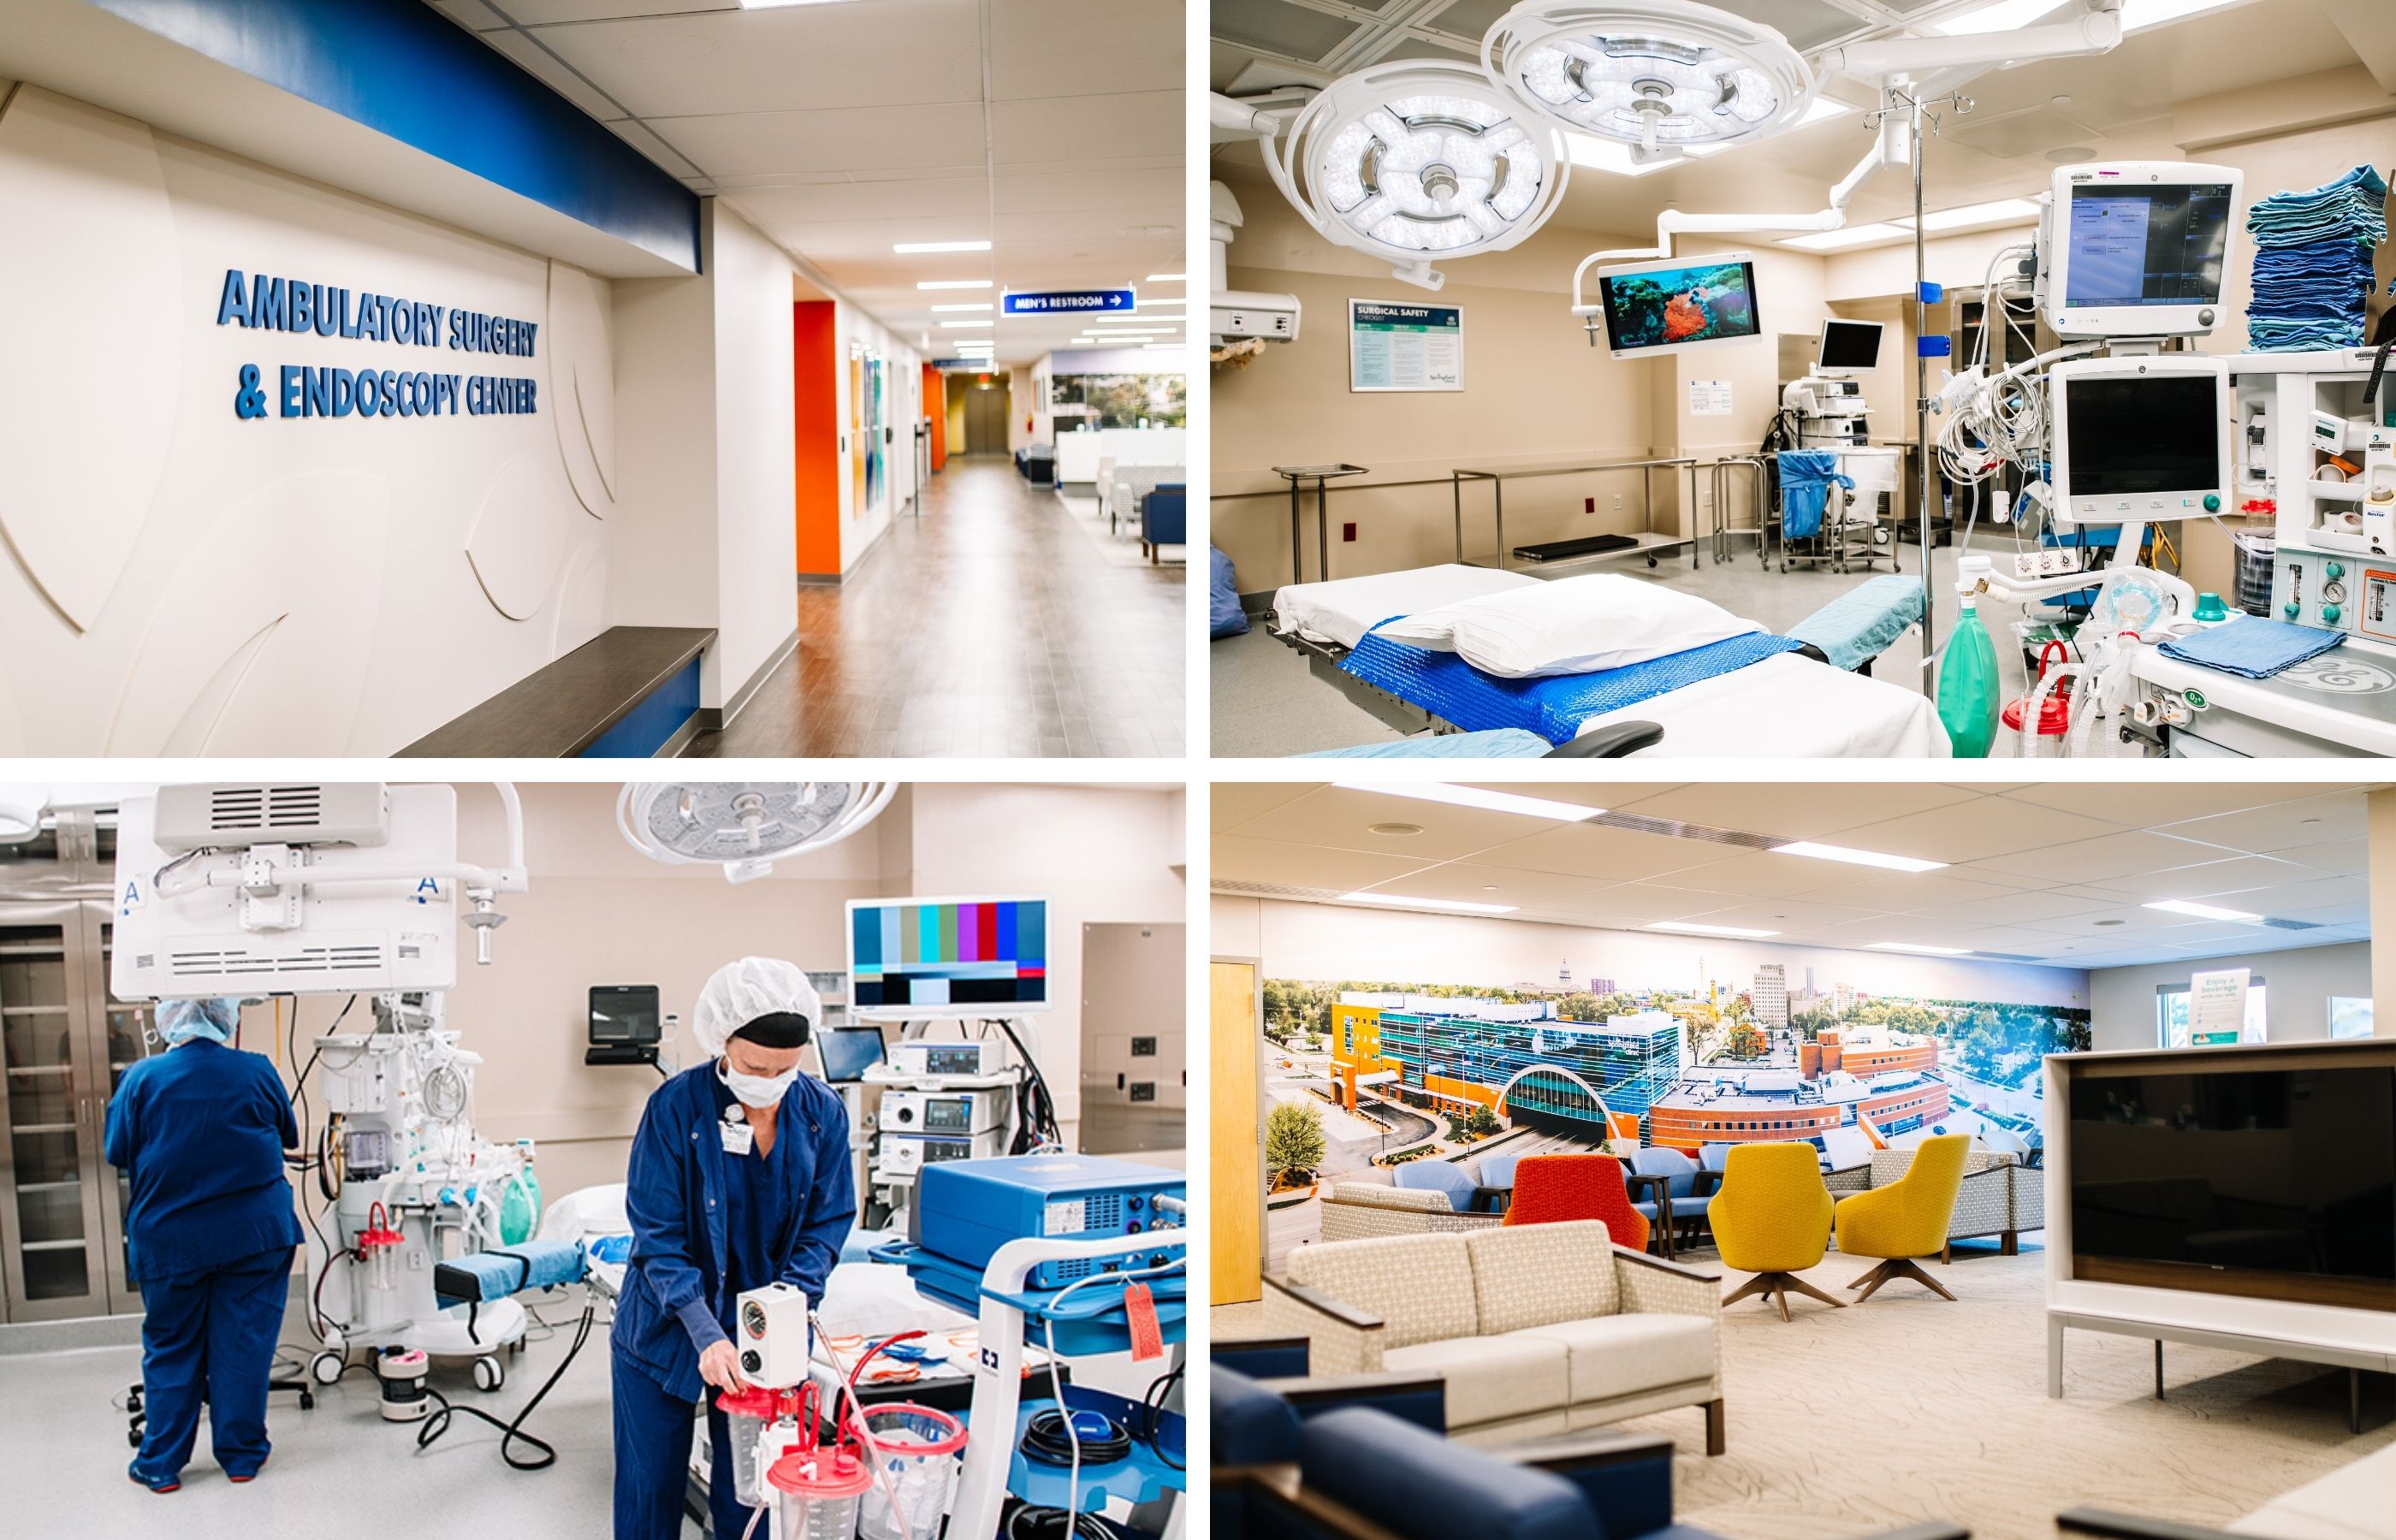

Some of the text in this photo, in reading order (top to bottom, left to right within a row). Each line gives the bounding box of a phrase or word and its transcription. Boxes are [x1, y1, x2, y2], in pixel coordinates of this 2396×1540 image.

[1015, 295, 1104, 309] MEN'S RESTROOM
[216, 269, 538, 358] AMBULATORY SURGERY
[1357, 306, 1429, 317] SURGICAL SAFETY
[234, 363, 538, 418] & ENDOSCOPY CENTER
[2206, 978, 2227, 986] Enjoy
[2201, 985, 2239, 993] beverage
[1608, 1040, 1640, 1050] Springfield
